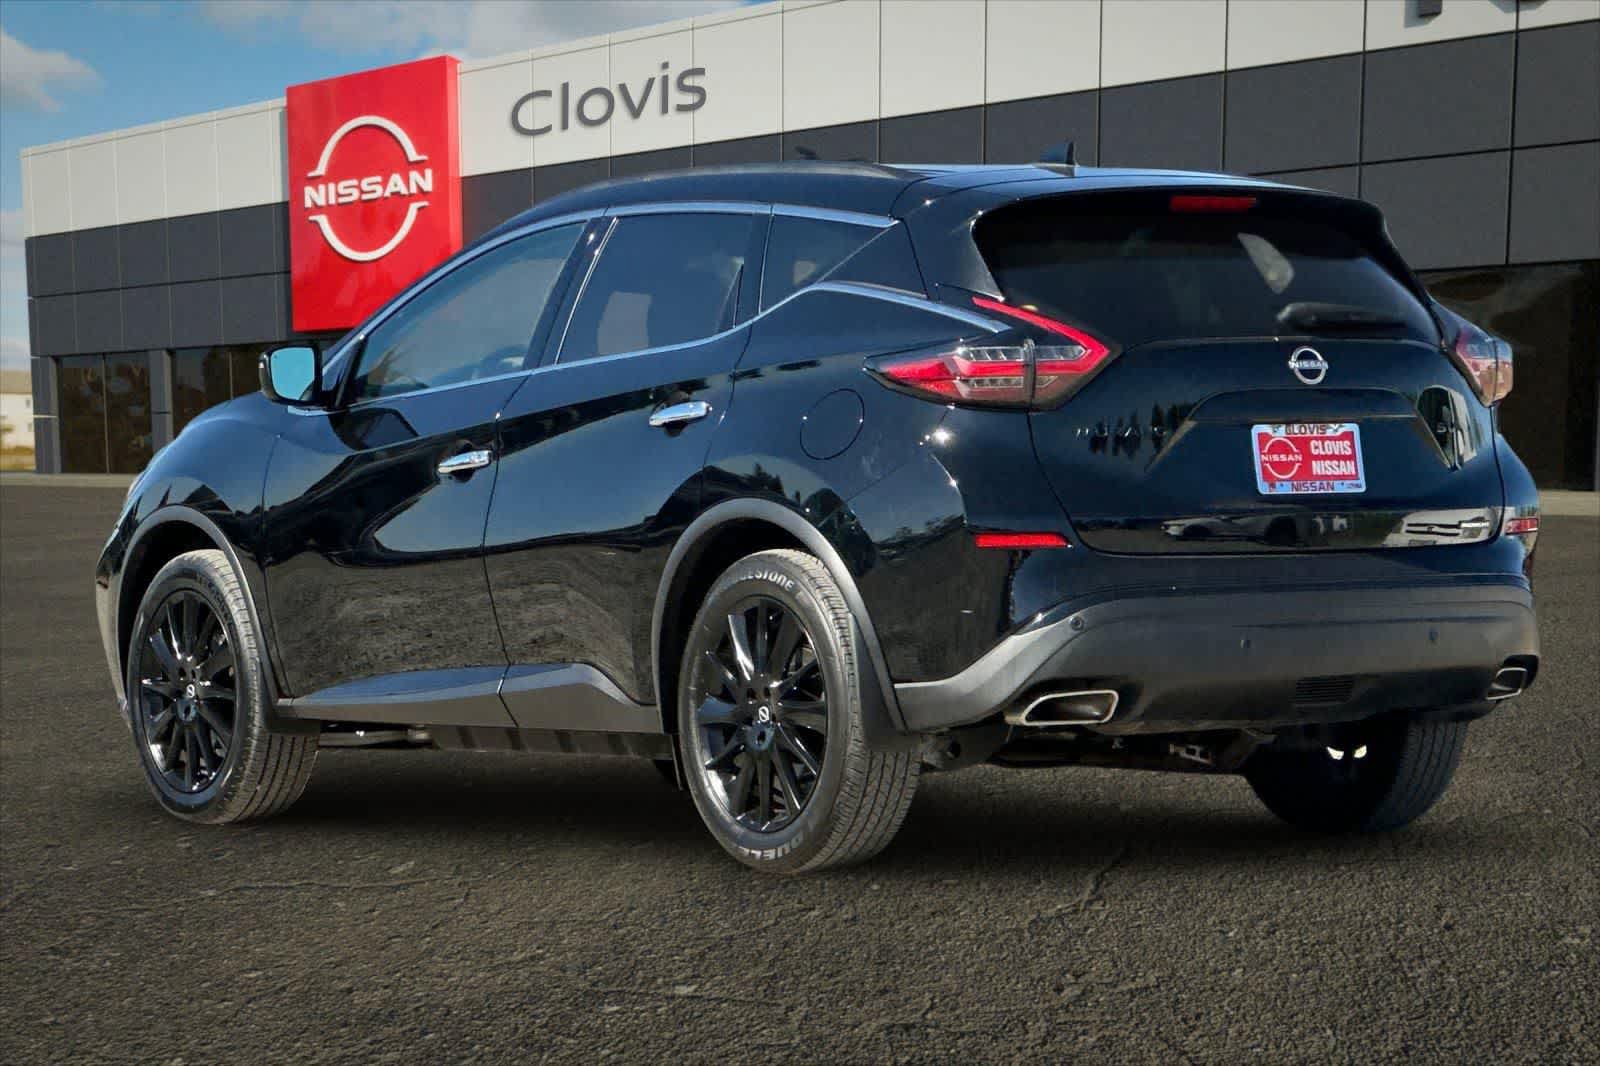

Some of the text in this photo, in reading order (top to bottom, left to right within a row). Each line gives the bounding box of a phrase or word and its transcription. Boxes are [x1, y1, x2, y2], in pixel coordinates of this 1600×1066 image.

[303, 168, 434, 209] NISSAN
[1310, 440, 1352, 455] CLOVIS
[1261, 453, 1303, 463] NISSAN
[1311, 460, 1356, 475] NISSAN
[1291, 481, 1335, 493] NISSAN
